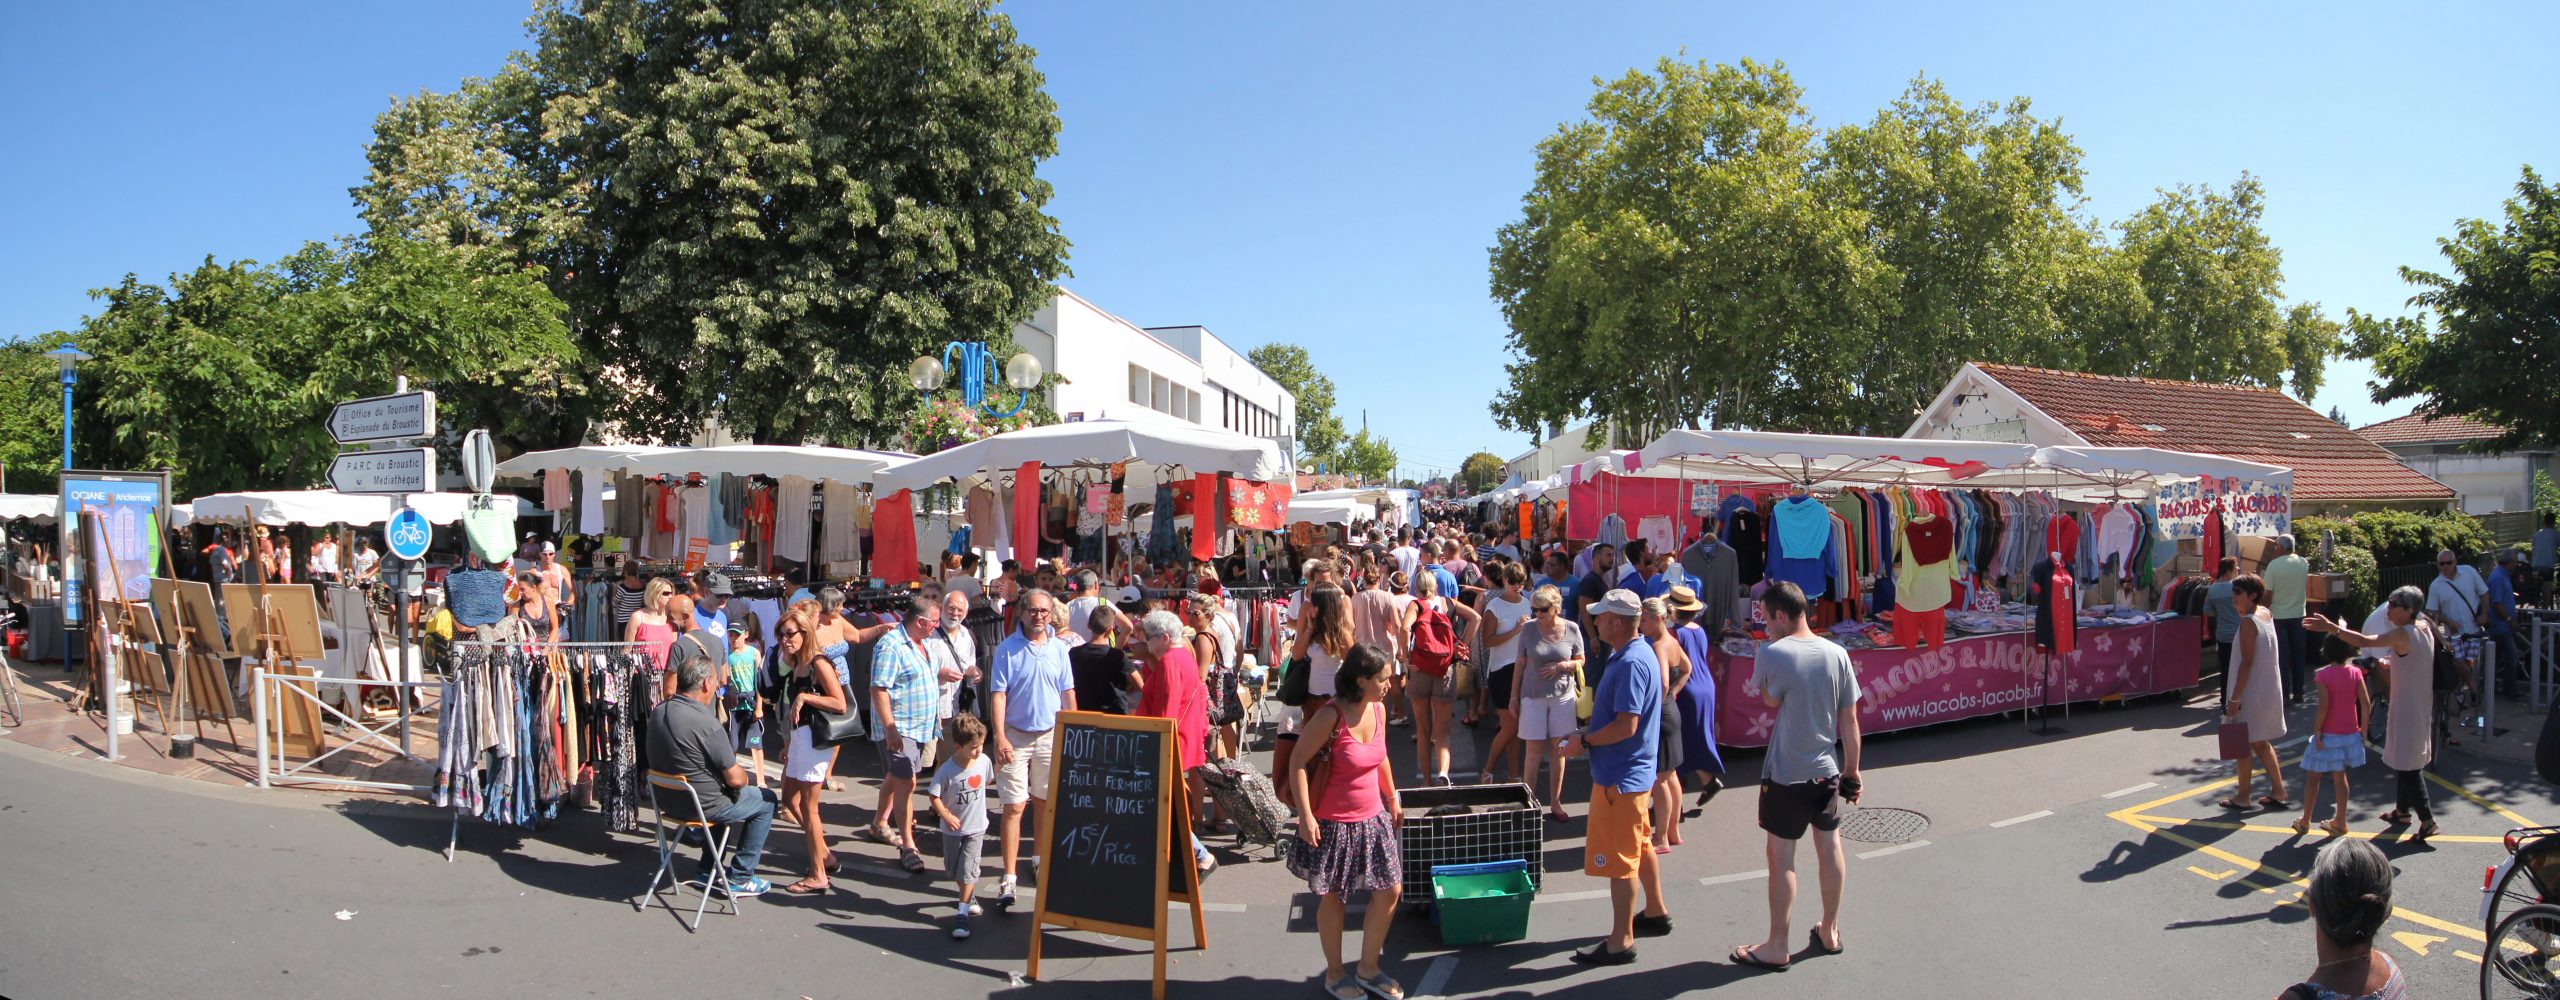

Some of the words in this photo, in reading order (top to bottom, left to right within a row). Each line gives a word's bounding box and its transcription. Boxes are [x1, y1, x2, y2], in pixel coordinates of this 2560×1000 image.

[351, 409, 371, 420] Office
[375, 407, 384, 416] du
[387, 403, 419, 415] Tourisme
[350, 422, 380, 434] Esplanade
[382, 420, 390, 430] du
[392, 417, 420, 430] Broustic
[376, 460, 385, 470] du
[388, 458, 420, 469] Broustic
[2158, 498, 2211, 519] JACOBS
[2215, 497, 2226, 513] &
[2232, 495, 2288, 514] JACOBS
[1861, 645, 1956, 714] JACOBS
[1959, 646, 1977, 669] &
[1979, 640, 2062, 686] JACOBS
[1882, 682, 2043, 722] www.jacobs-jacobs.fr
[960, 779, 966, 791] I
[1105, 775, 1152, 793] FERMIER
[957, 786, 982, 805] NY
